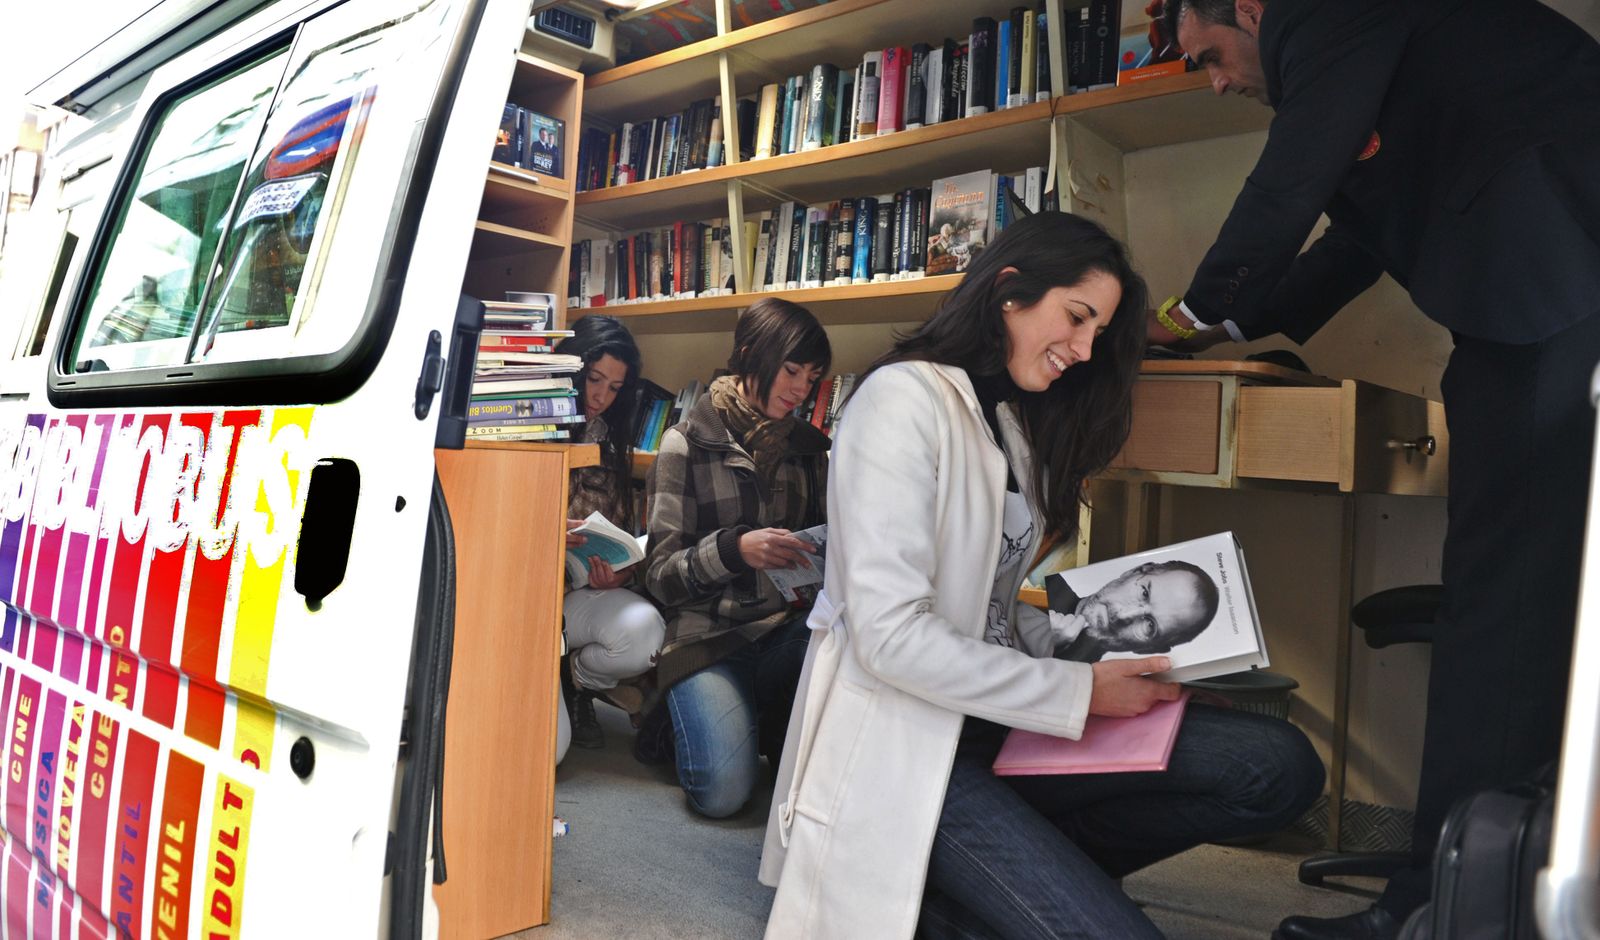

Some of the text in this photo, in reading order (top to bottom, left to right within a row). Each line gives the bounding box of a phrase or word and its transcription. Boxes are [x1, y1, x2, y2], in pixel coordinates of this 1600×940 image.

[482, 405, 512, 414] Cuentos
[11, 692, 31, 783] CINE
[56, 702, 87, 872] NOVELA
[90, 624, 128, 799] CUENTO
[210, 748, 261, 940] DULTO
